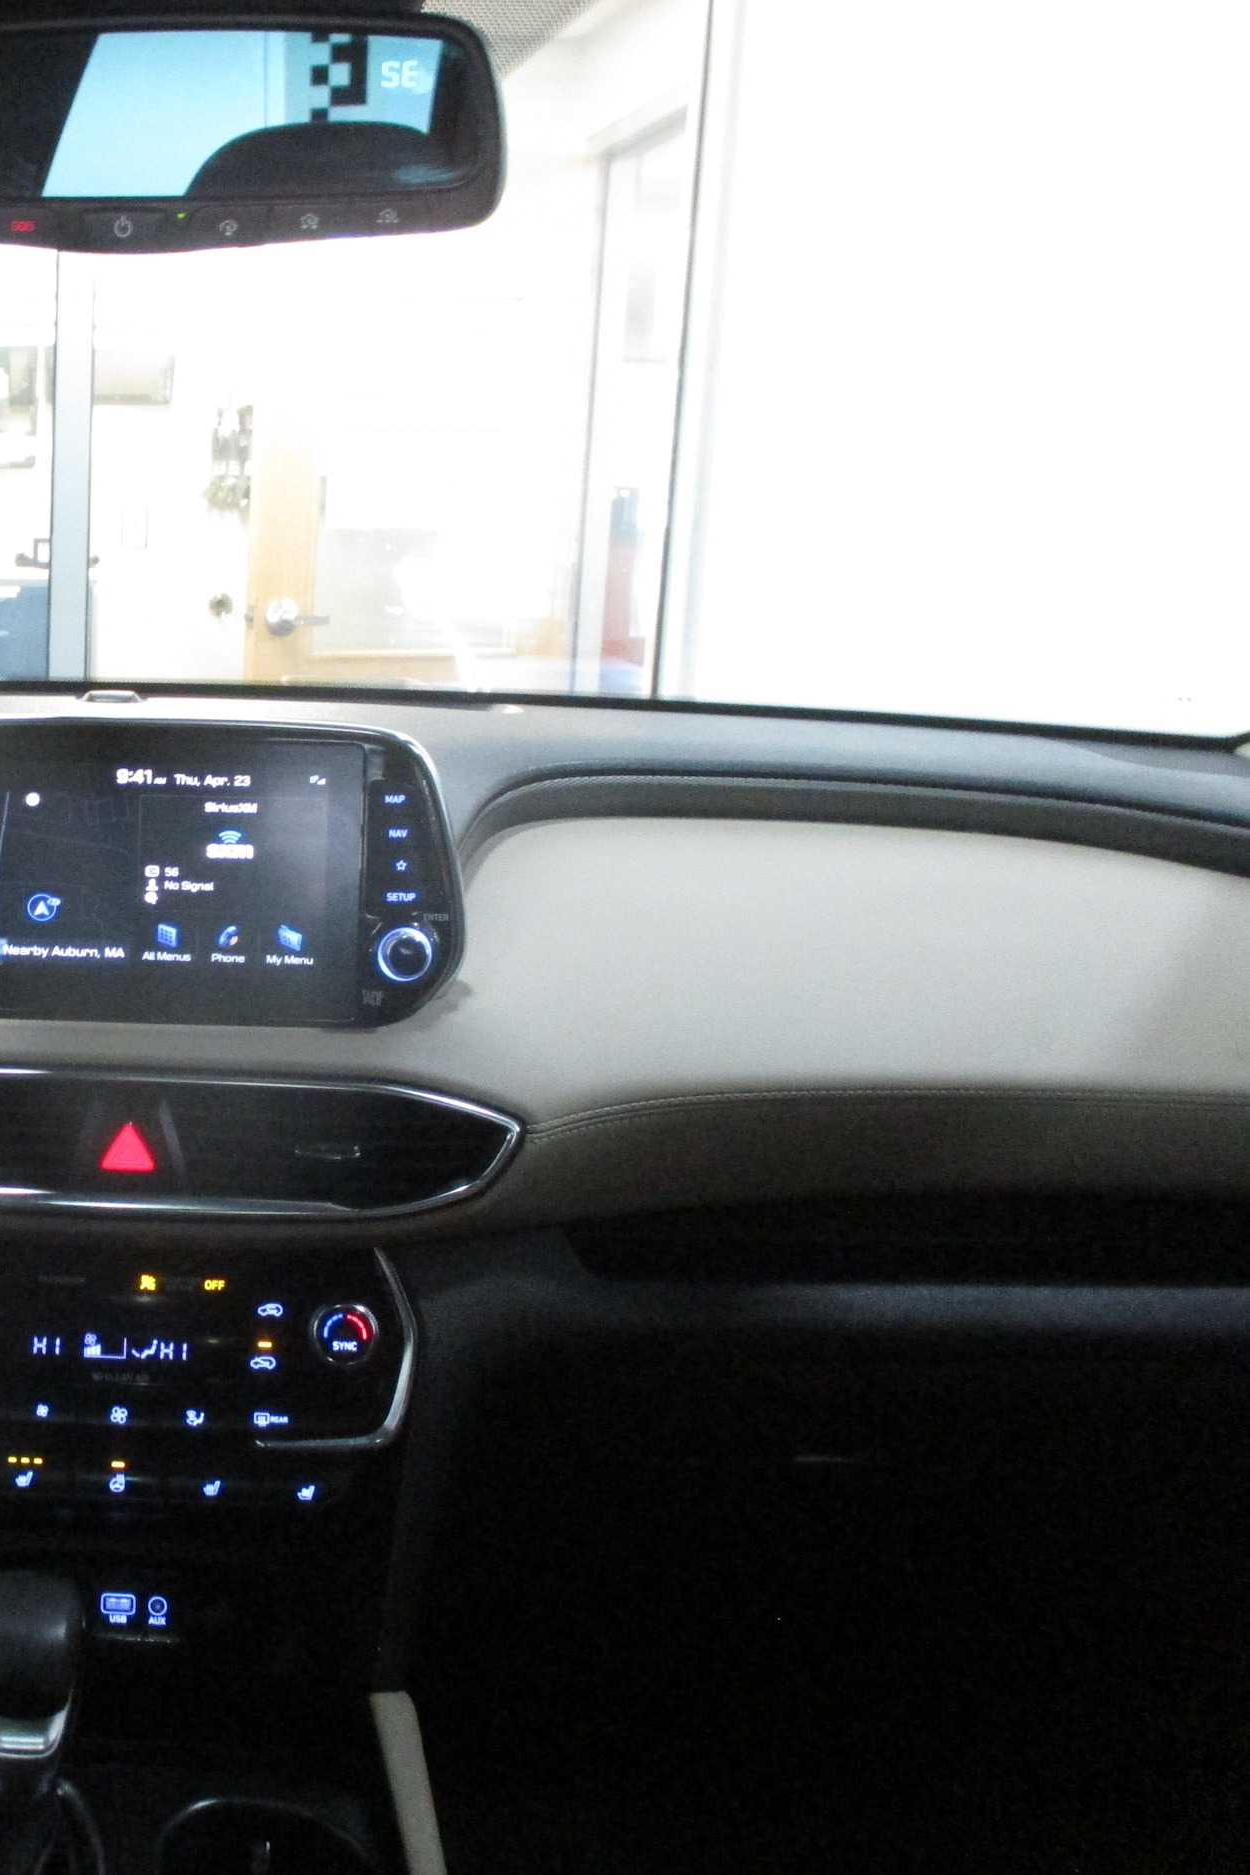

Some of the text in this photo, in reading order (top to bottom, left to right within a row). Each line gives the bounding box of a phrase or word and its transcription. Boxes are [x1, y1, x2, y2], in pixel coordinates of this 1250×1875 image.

[380, 60, 419, 88] SE
[174, 773, 201, 787] Thu,
[203, 774, 231, 788] Apr.
[234, 775, 251, 787] 23
[385, 795, 405, 804] MAP
[388, 829, 408, 838] NAV
[164, 880, 215, 893] No Signal
[386, 892, 416, 902] SETUP
[423, 913, 449, 922] ENTER
[3, 944, 125, 959] Nearby Auburn, MA
[142, 951, 191, 963] All Menus
[211, 953, 246, 964] Phone
[266, 955, 314, 966] My Menu
[203, 1279, 226, 1291] OFF
[33, 1336, 61, 1355] HI
[160, 1341, 188, 1361] HI
[332, 1340, 358, 1351] SYNC
[270, 1415, 289, 1424] REAR
[109, 1614, 128, 1624] USB
[148, 1616, 167, 1626] AUX
